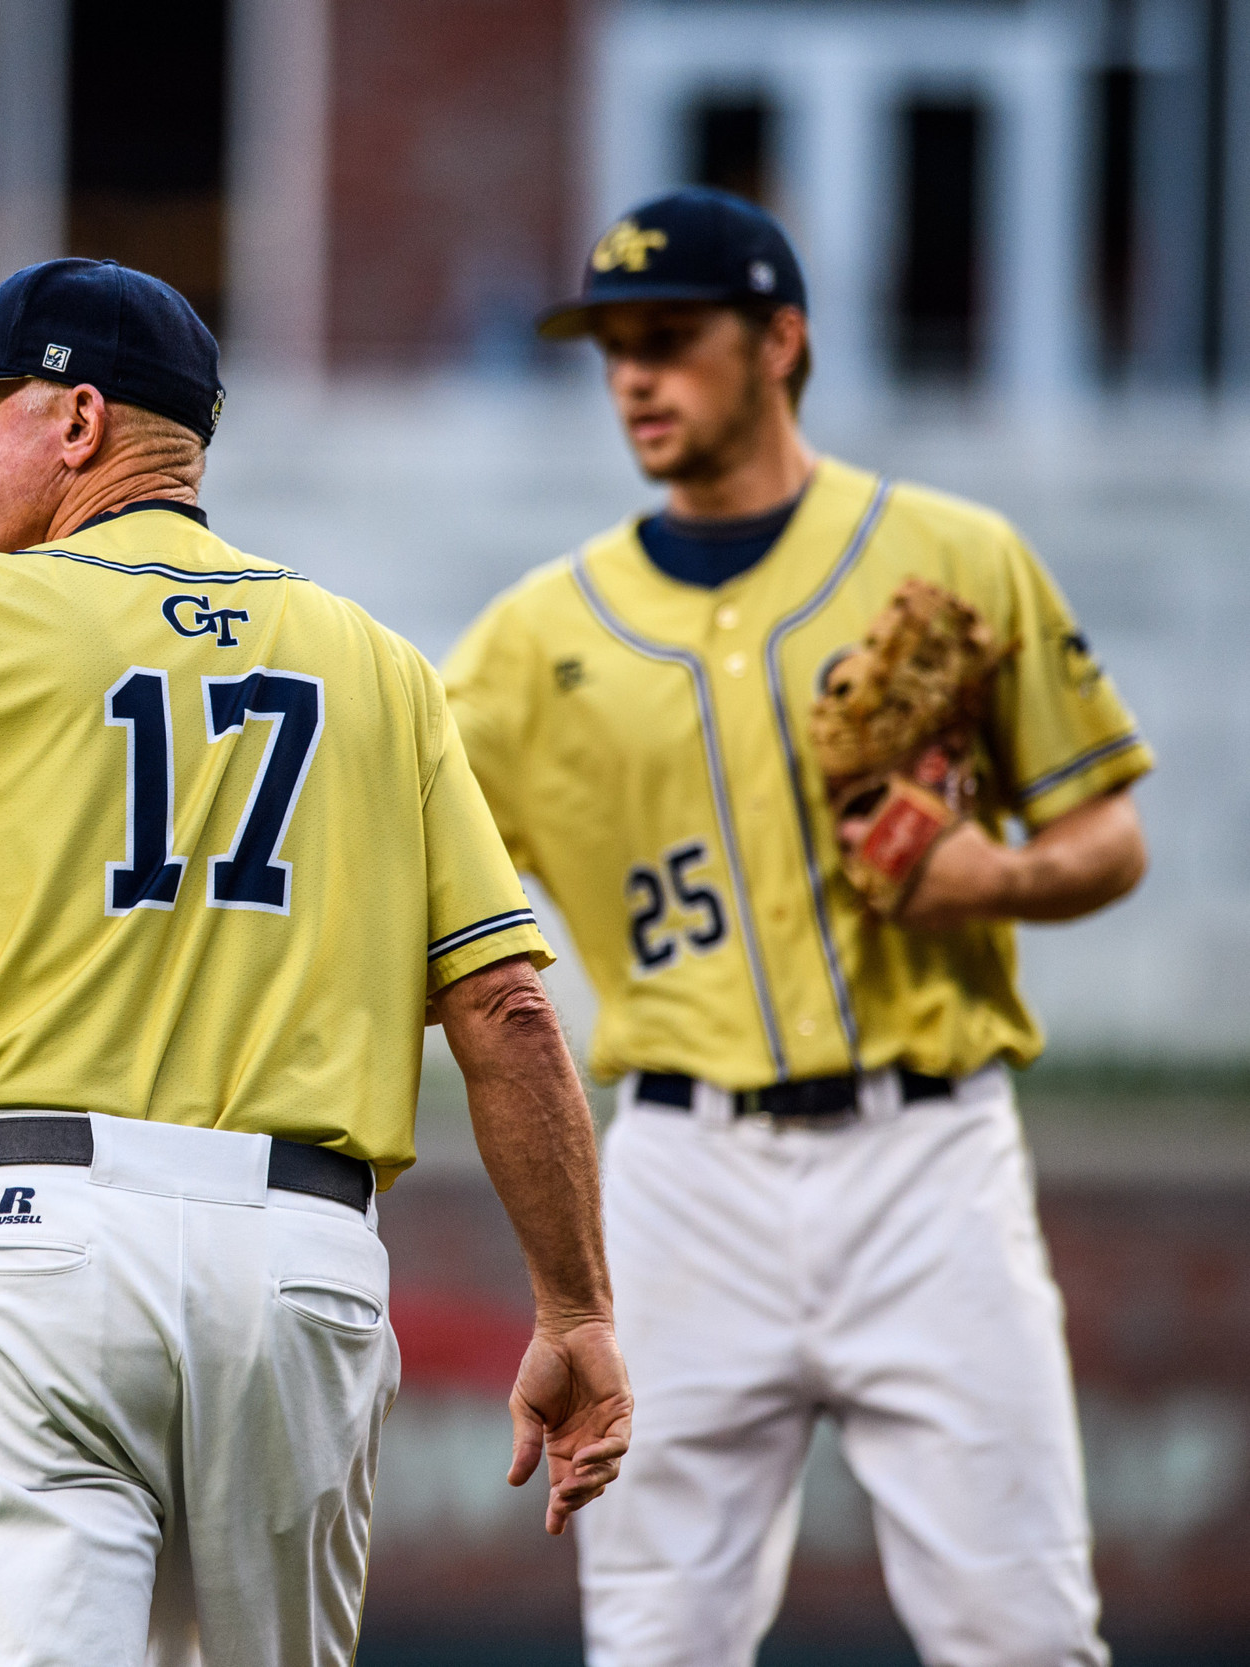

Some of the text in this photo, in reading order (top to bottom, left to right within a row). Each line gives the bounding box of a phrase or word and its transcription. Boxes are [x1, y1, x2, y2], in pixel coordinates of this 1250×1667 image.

[161, 593, 250, 648] GT
[104, 665, 325, 916] 17
[625, 837, 728, 978] 25
